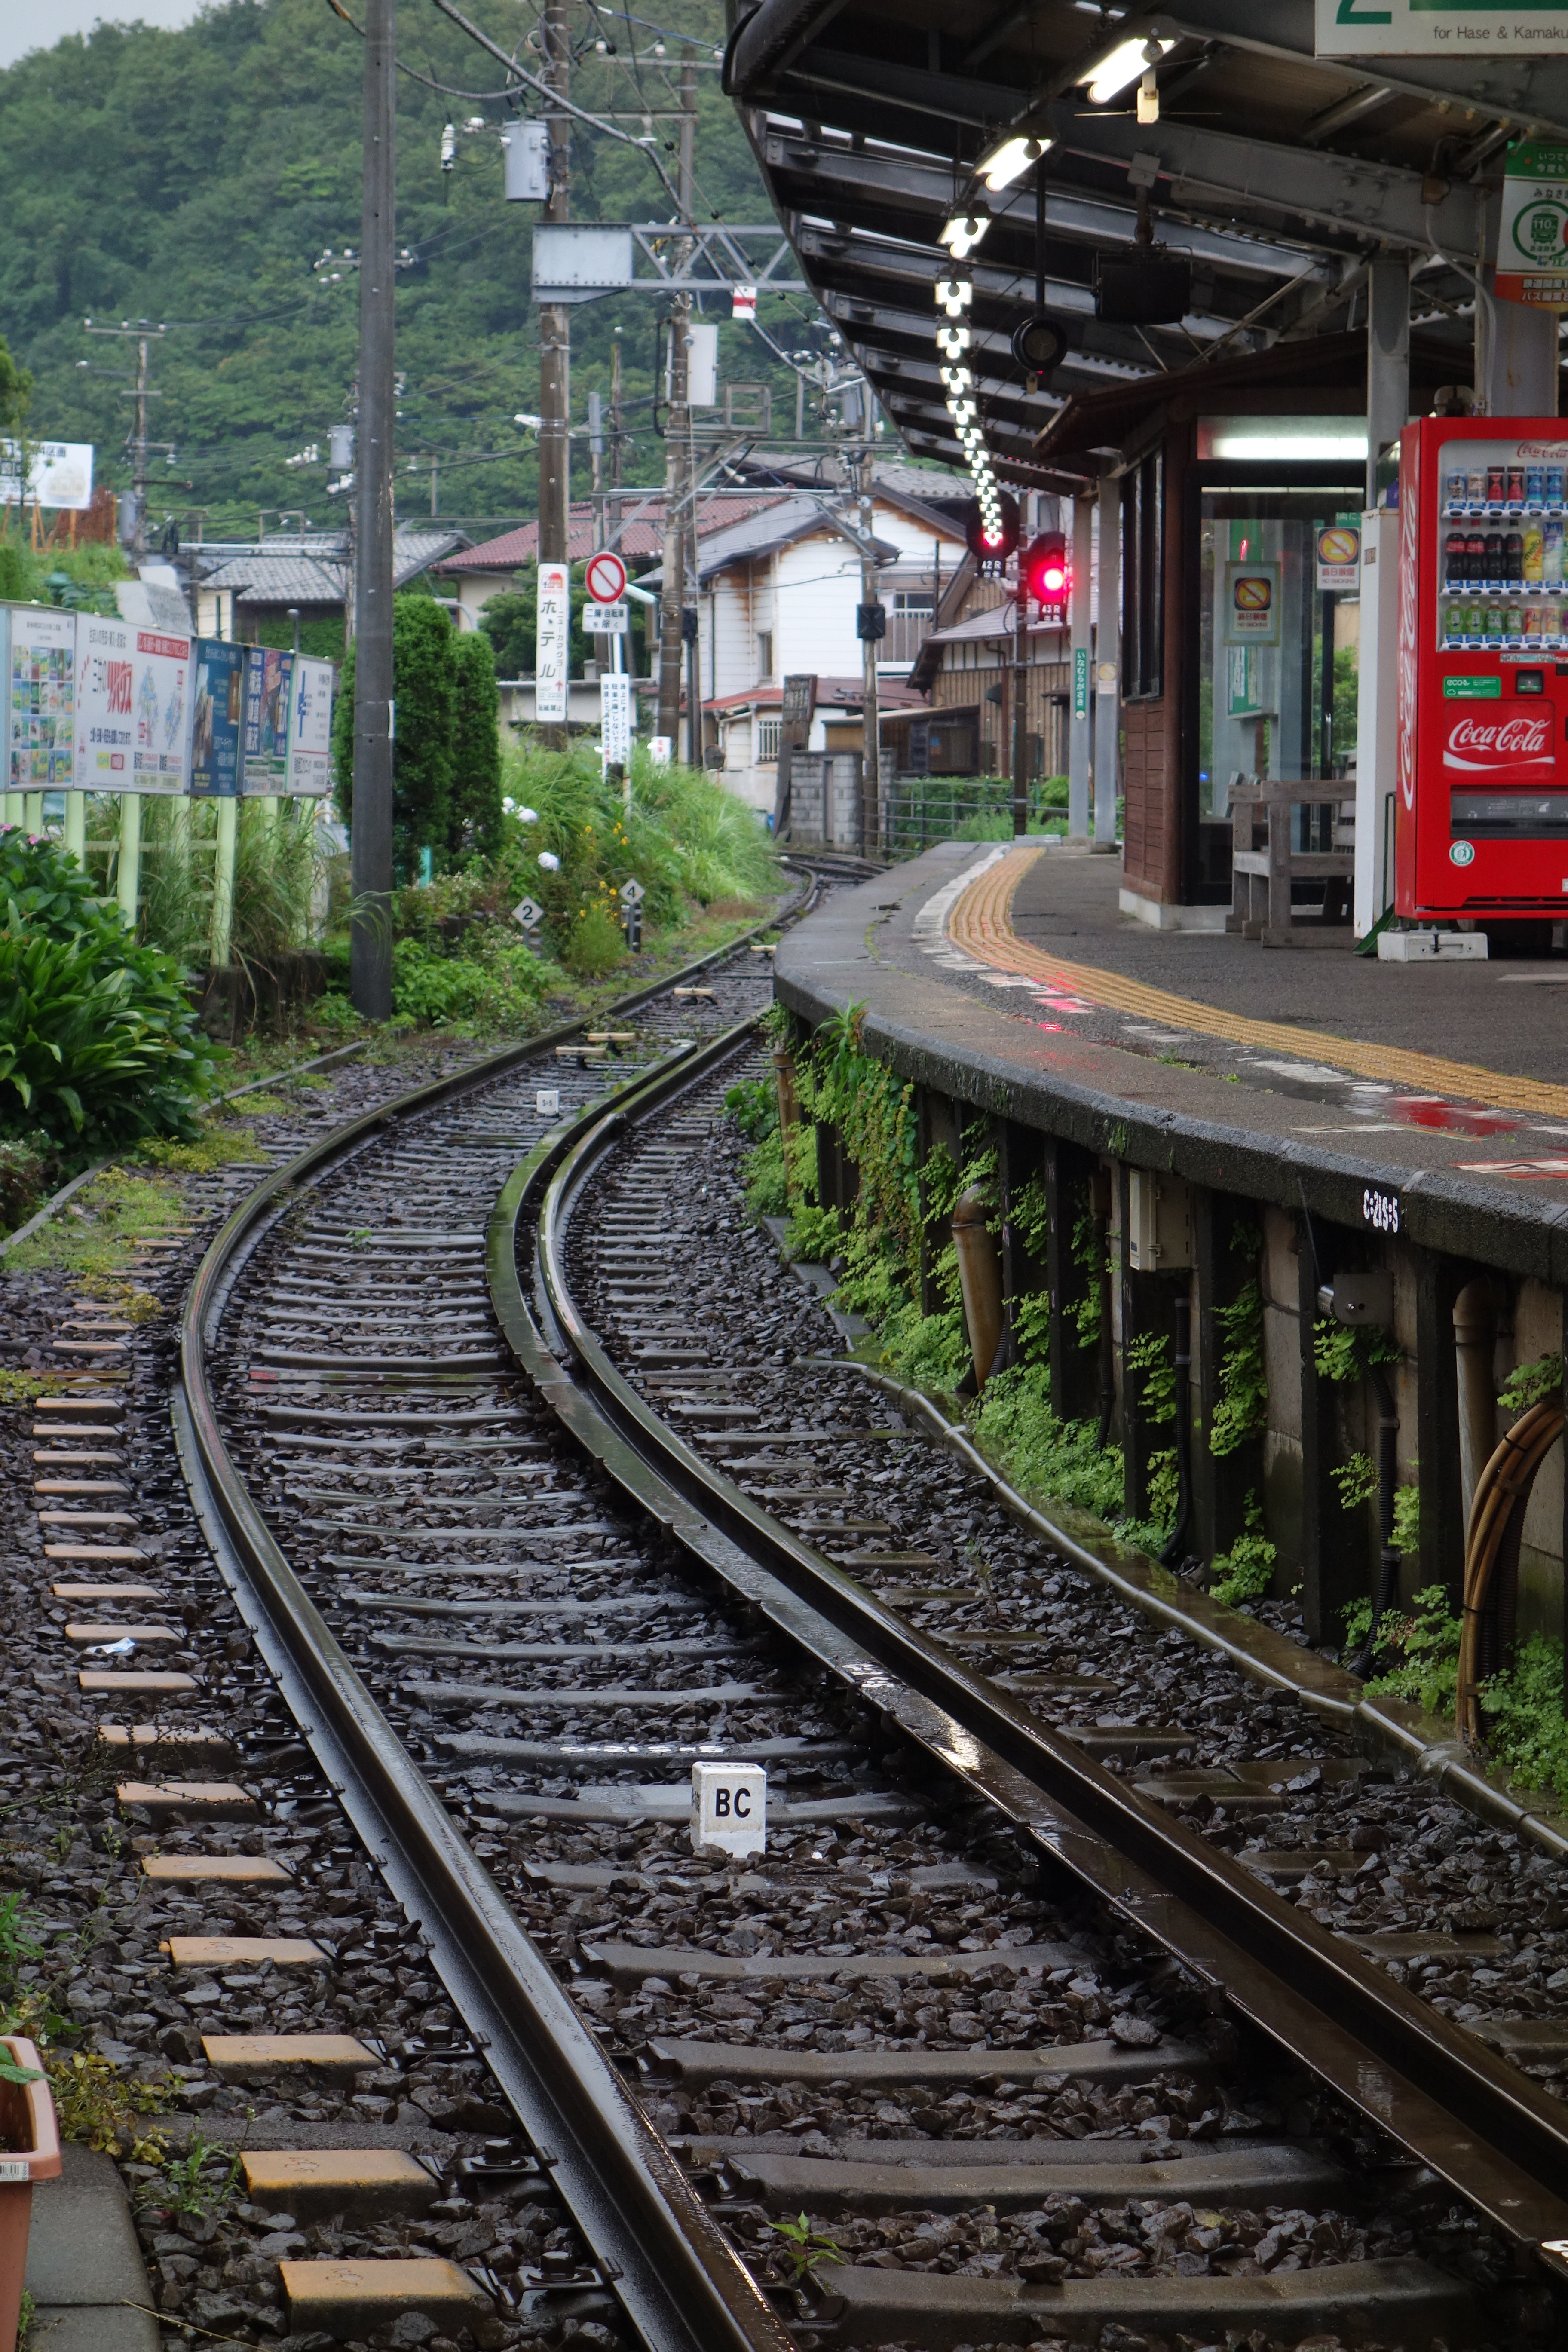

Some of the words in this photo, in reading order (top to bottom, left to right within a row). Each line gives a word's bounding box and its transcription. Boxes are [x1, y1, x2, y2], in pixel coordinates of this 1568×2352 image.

[1433, 26, 1452, 39] for
[1457, 27, 1490, 39] Hase
[1497, 27, 1508, 39] &
[1448, 718, 1552, 752] Coca-Cola
[627, 886, 637, 898] 4
[522, 905, 533, 920] 2
[715, 1788, 751, 1818] BC
